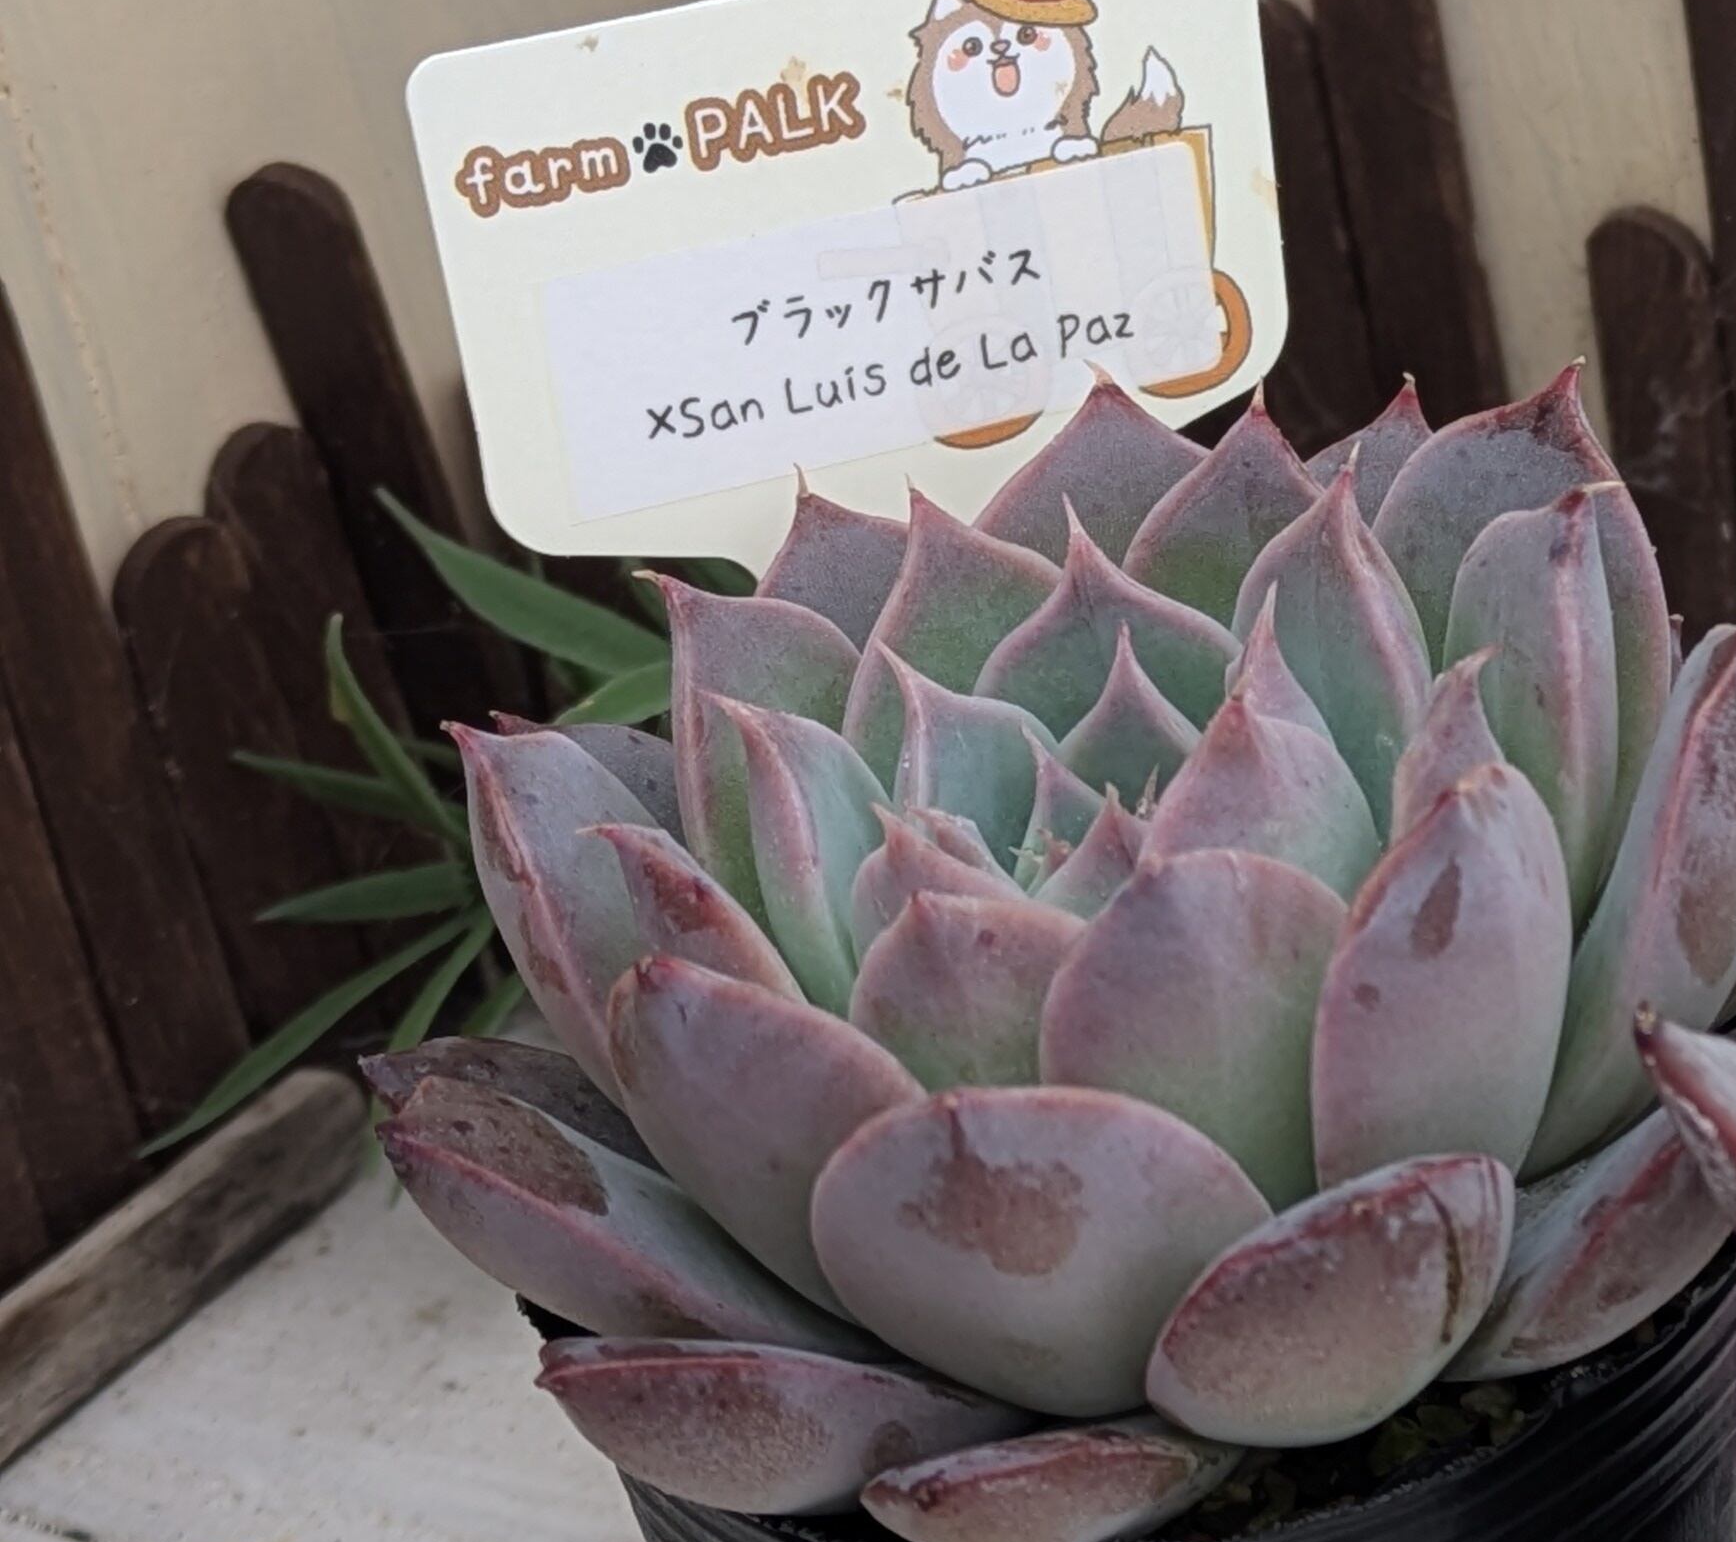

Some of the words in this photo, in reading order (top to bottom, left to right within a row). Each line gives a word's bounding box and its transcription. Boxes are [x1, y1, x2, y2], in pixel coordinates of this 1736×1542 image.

[462, 140, 624, 209] farm
[690, 79, 860, 162] PALK
[729, 246, 1043, 347] ブラックサバス
[784, 363, 889, 416] Luis
[908, 340, 962, 389] de
[979, 327, 1038, 370] La
[1056, 308, 1136, 361] Paz
